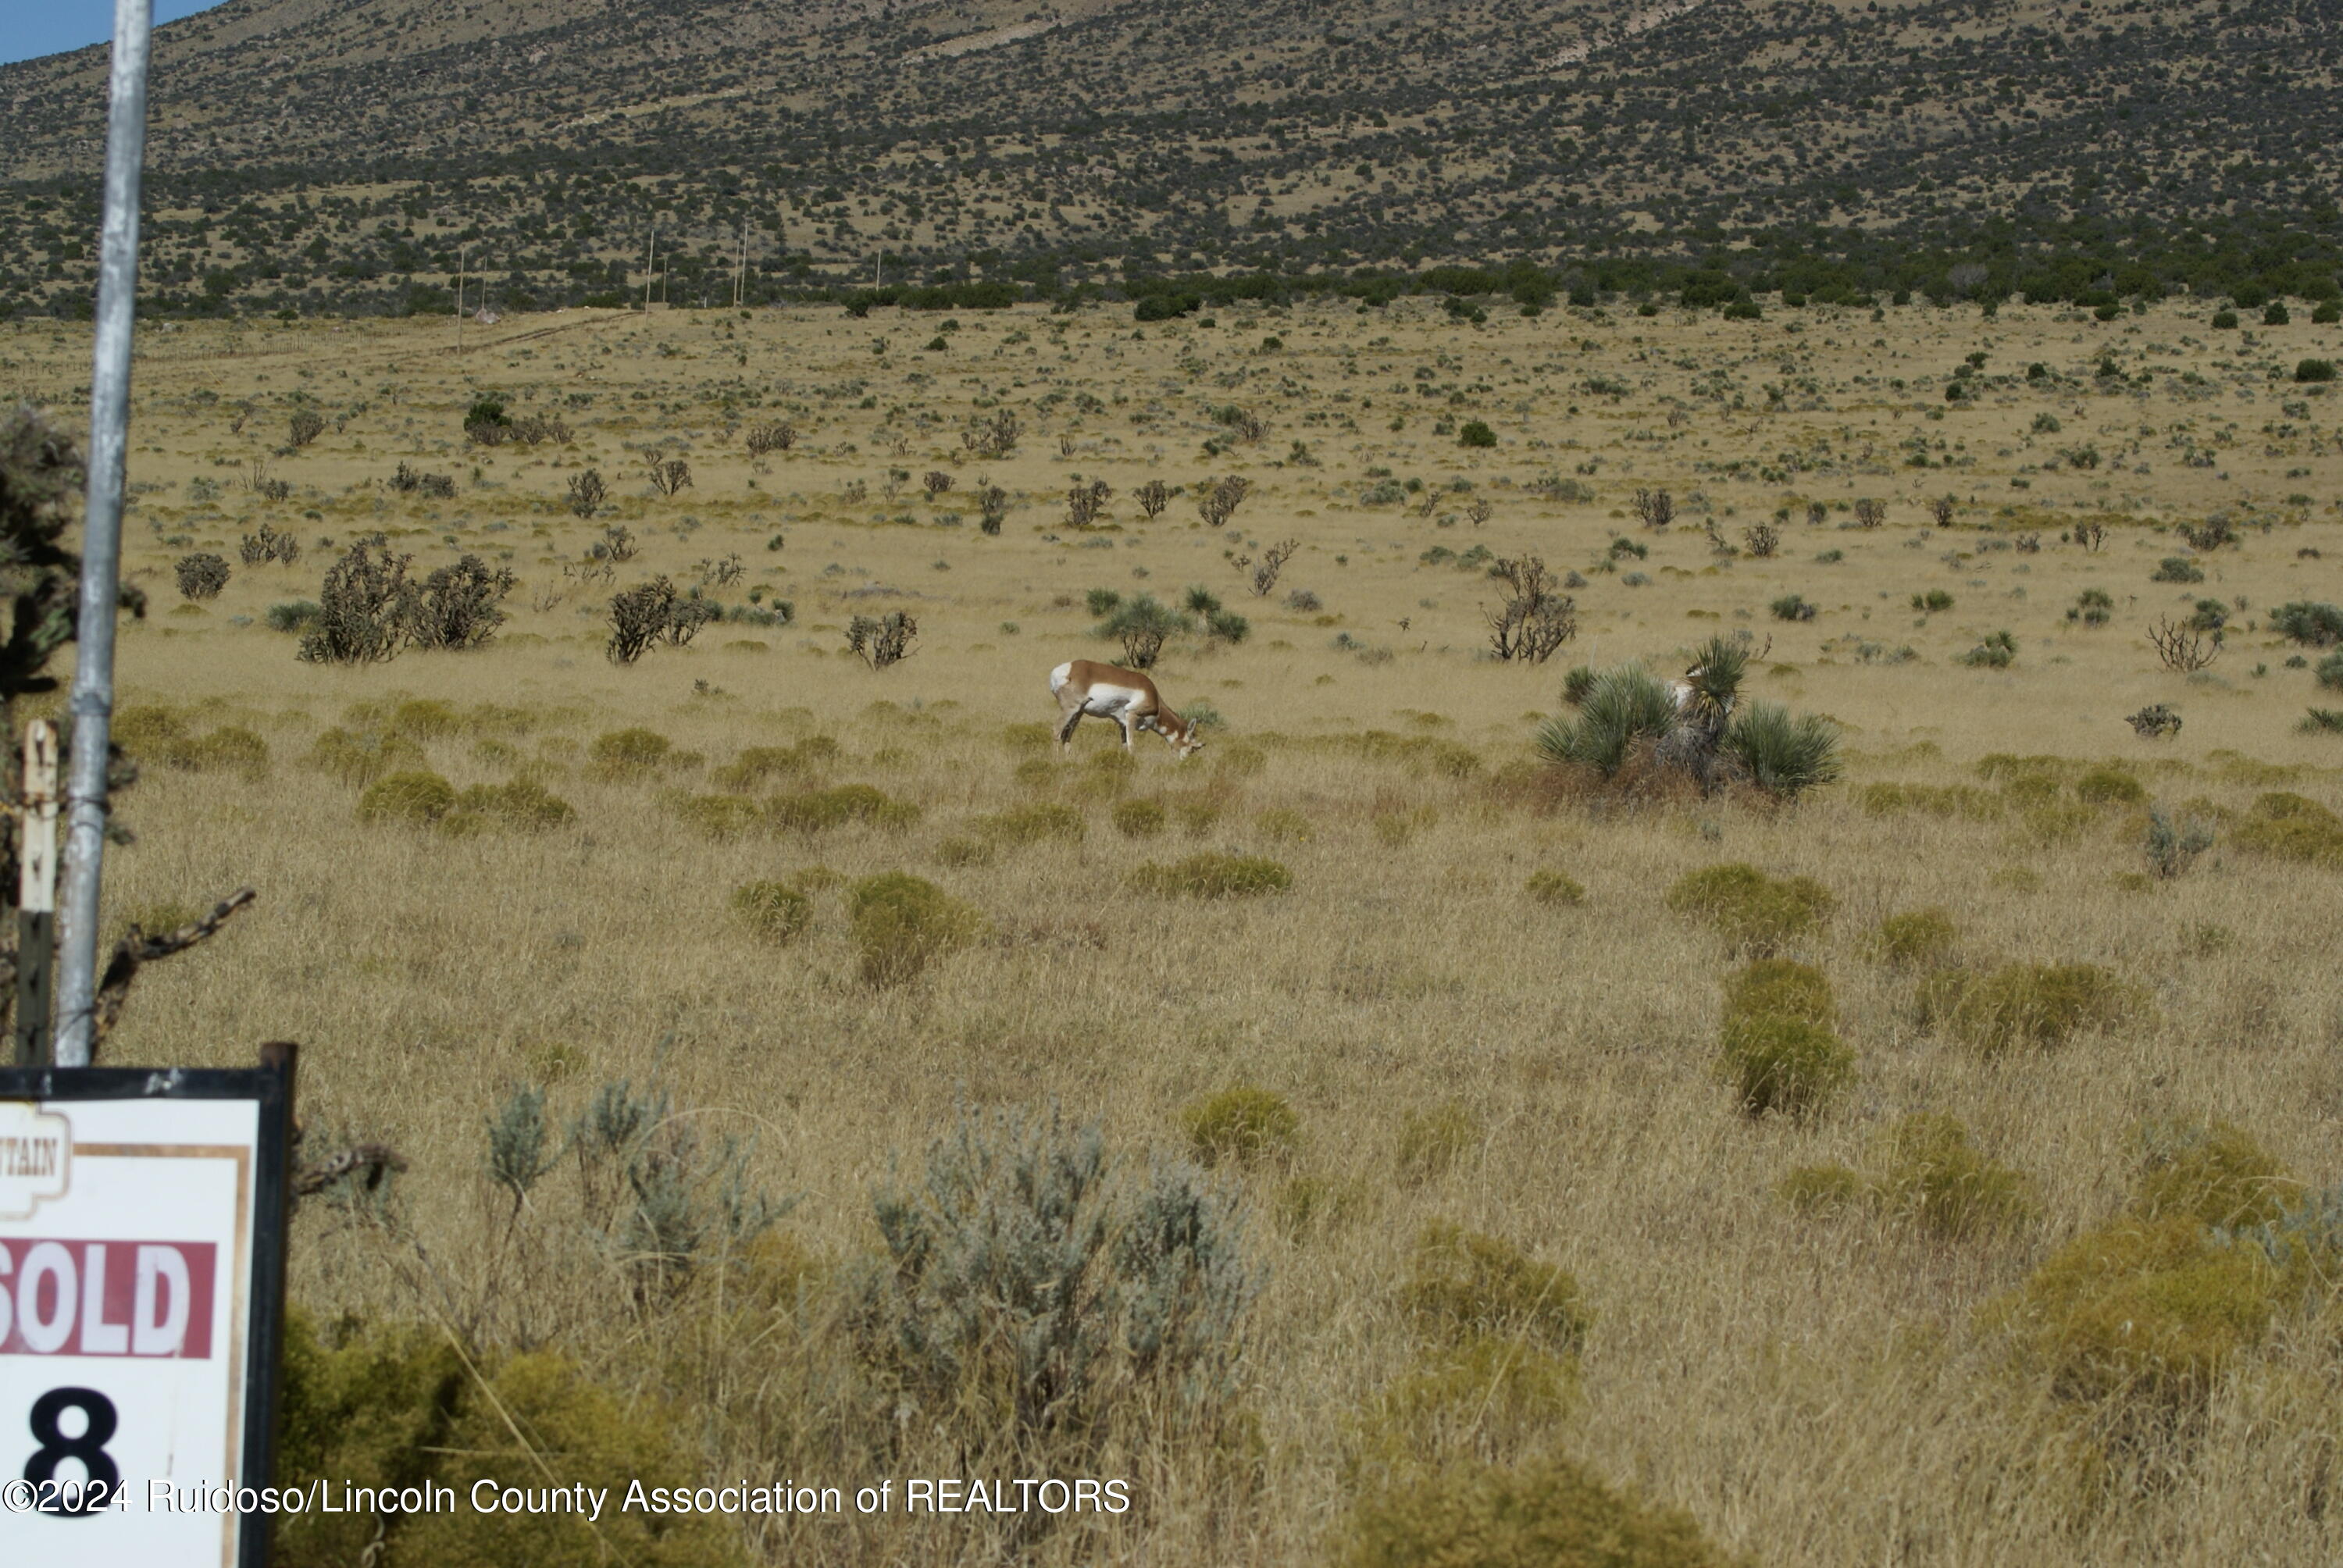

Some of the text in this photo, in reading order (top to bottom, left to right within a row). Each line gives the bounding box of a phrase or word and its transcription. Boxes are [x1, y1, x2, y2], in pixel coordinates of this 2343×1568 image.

[0, 1137, 57, 1176] TAIN
[0, 1240, 191, 1356] OLD
[23, 1386, 119, 1517] 8
